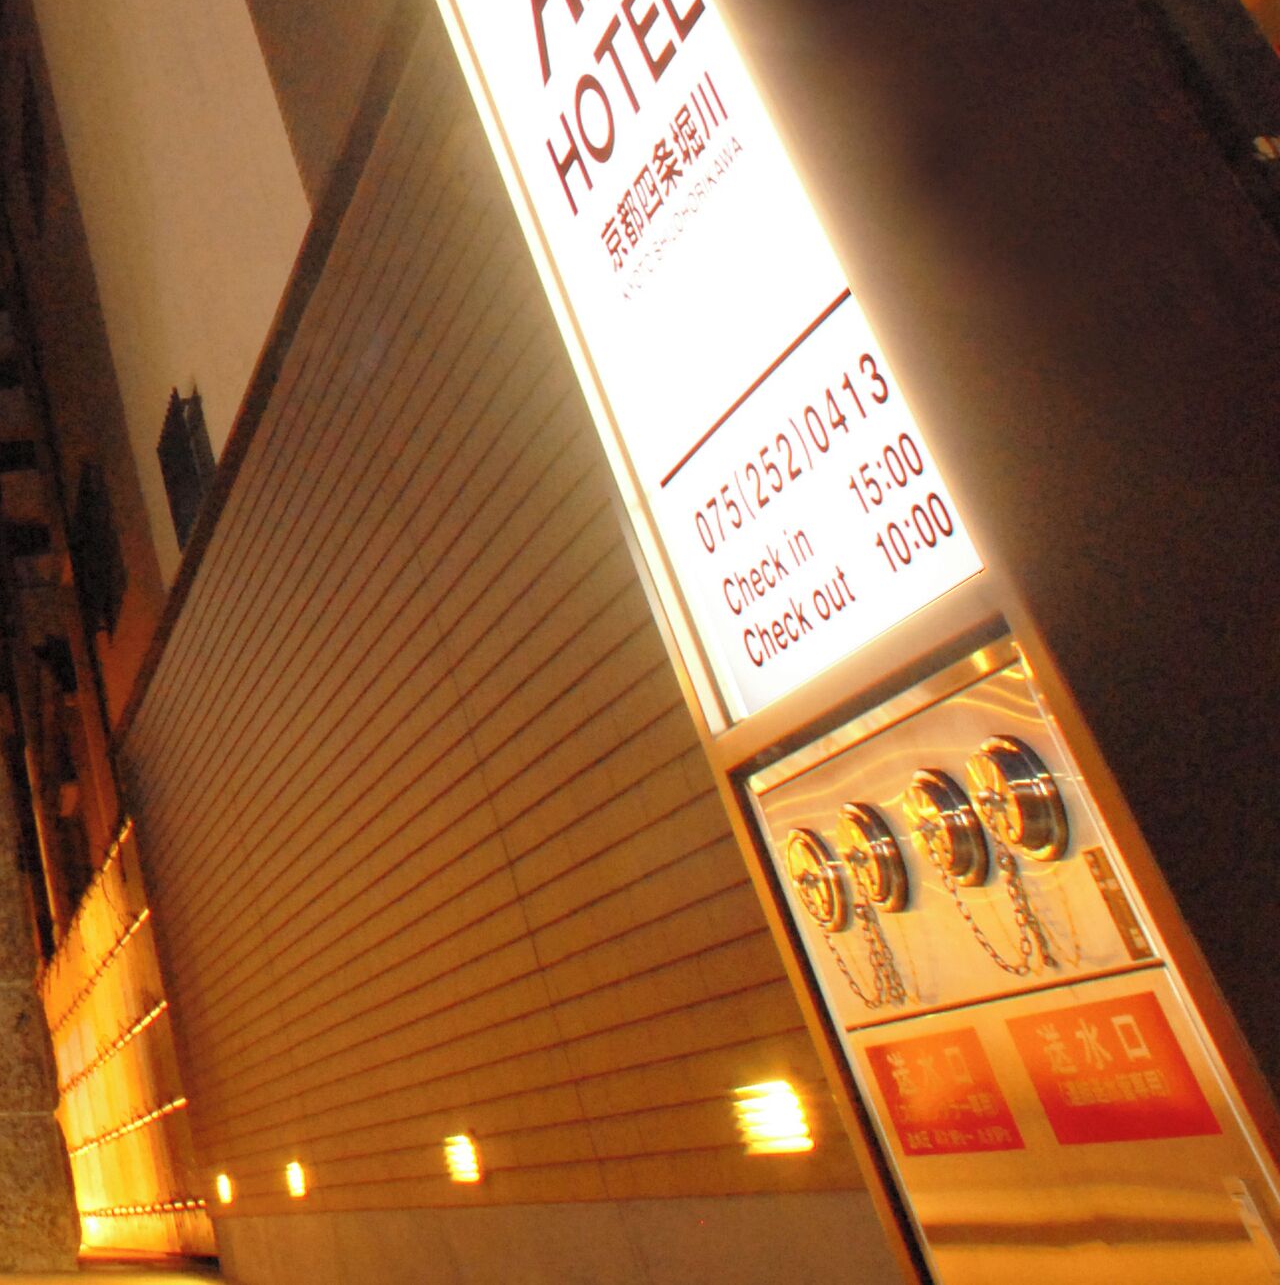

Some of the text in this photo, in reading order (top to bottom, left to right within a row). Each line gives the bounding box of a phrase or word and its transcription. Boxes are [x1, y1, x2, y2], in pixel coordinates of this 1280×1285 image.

[600, 71, 728, 272] 京都四条堀川
[694, 353, 889, 554] 075(252)0413
[722, 432, 923, 616] Check in 15:00
[744, 493, 954, 668] Check out 10:00
[886, 1043, 973, 1098] 送水口
[1036, 1014, 1151, 1075] 送水口
